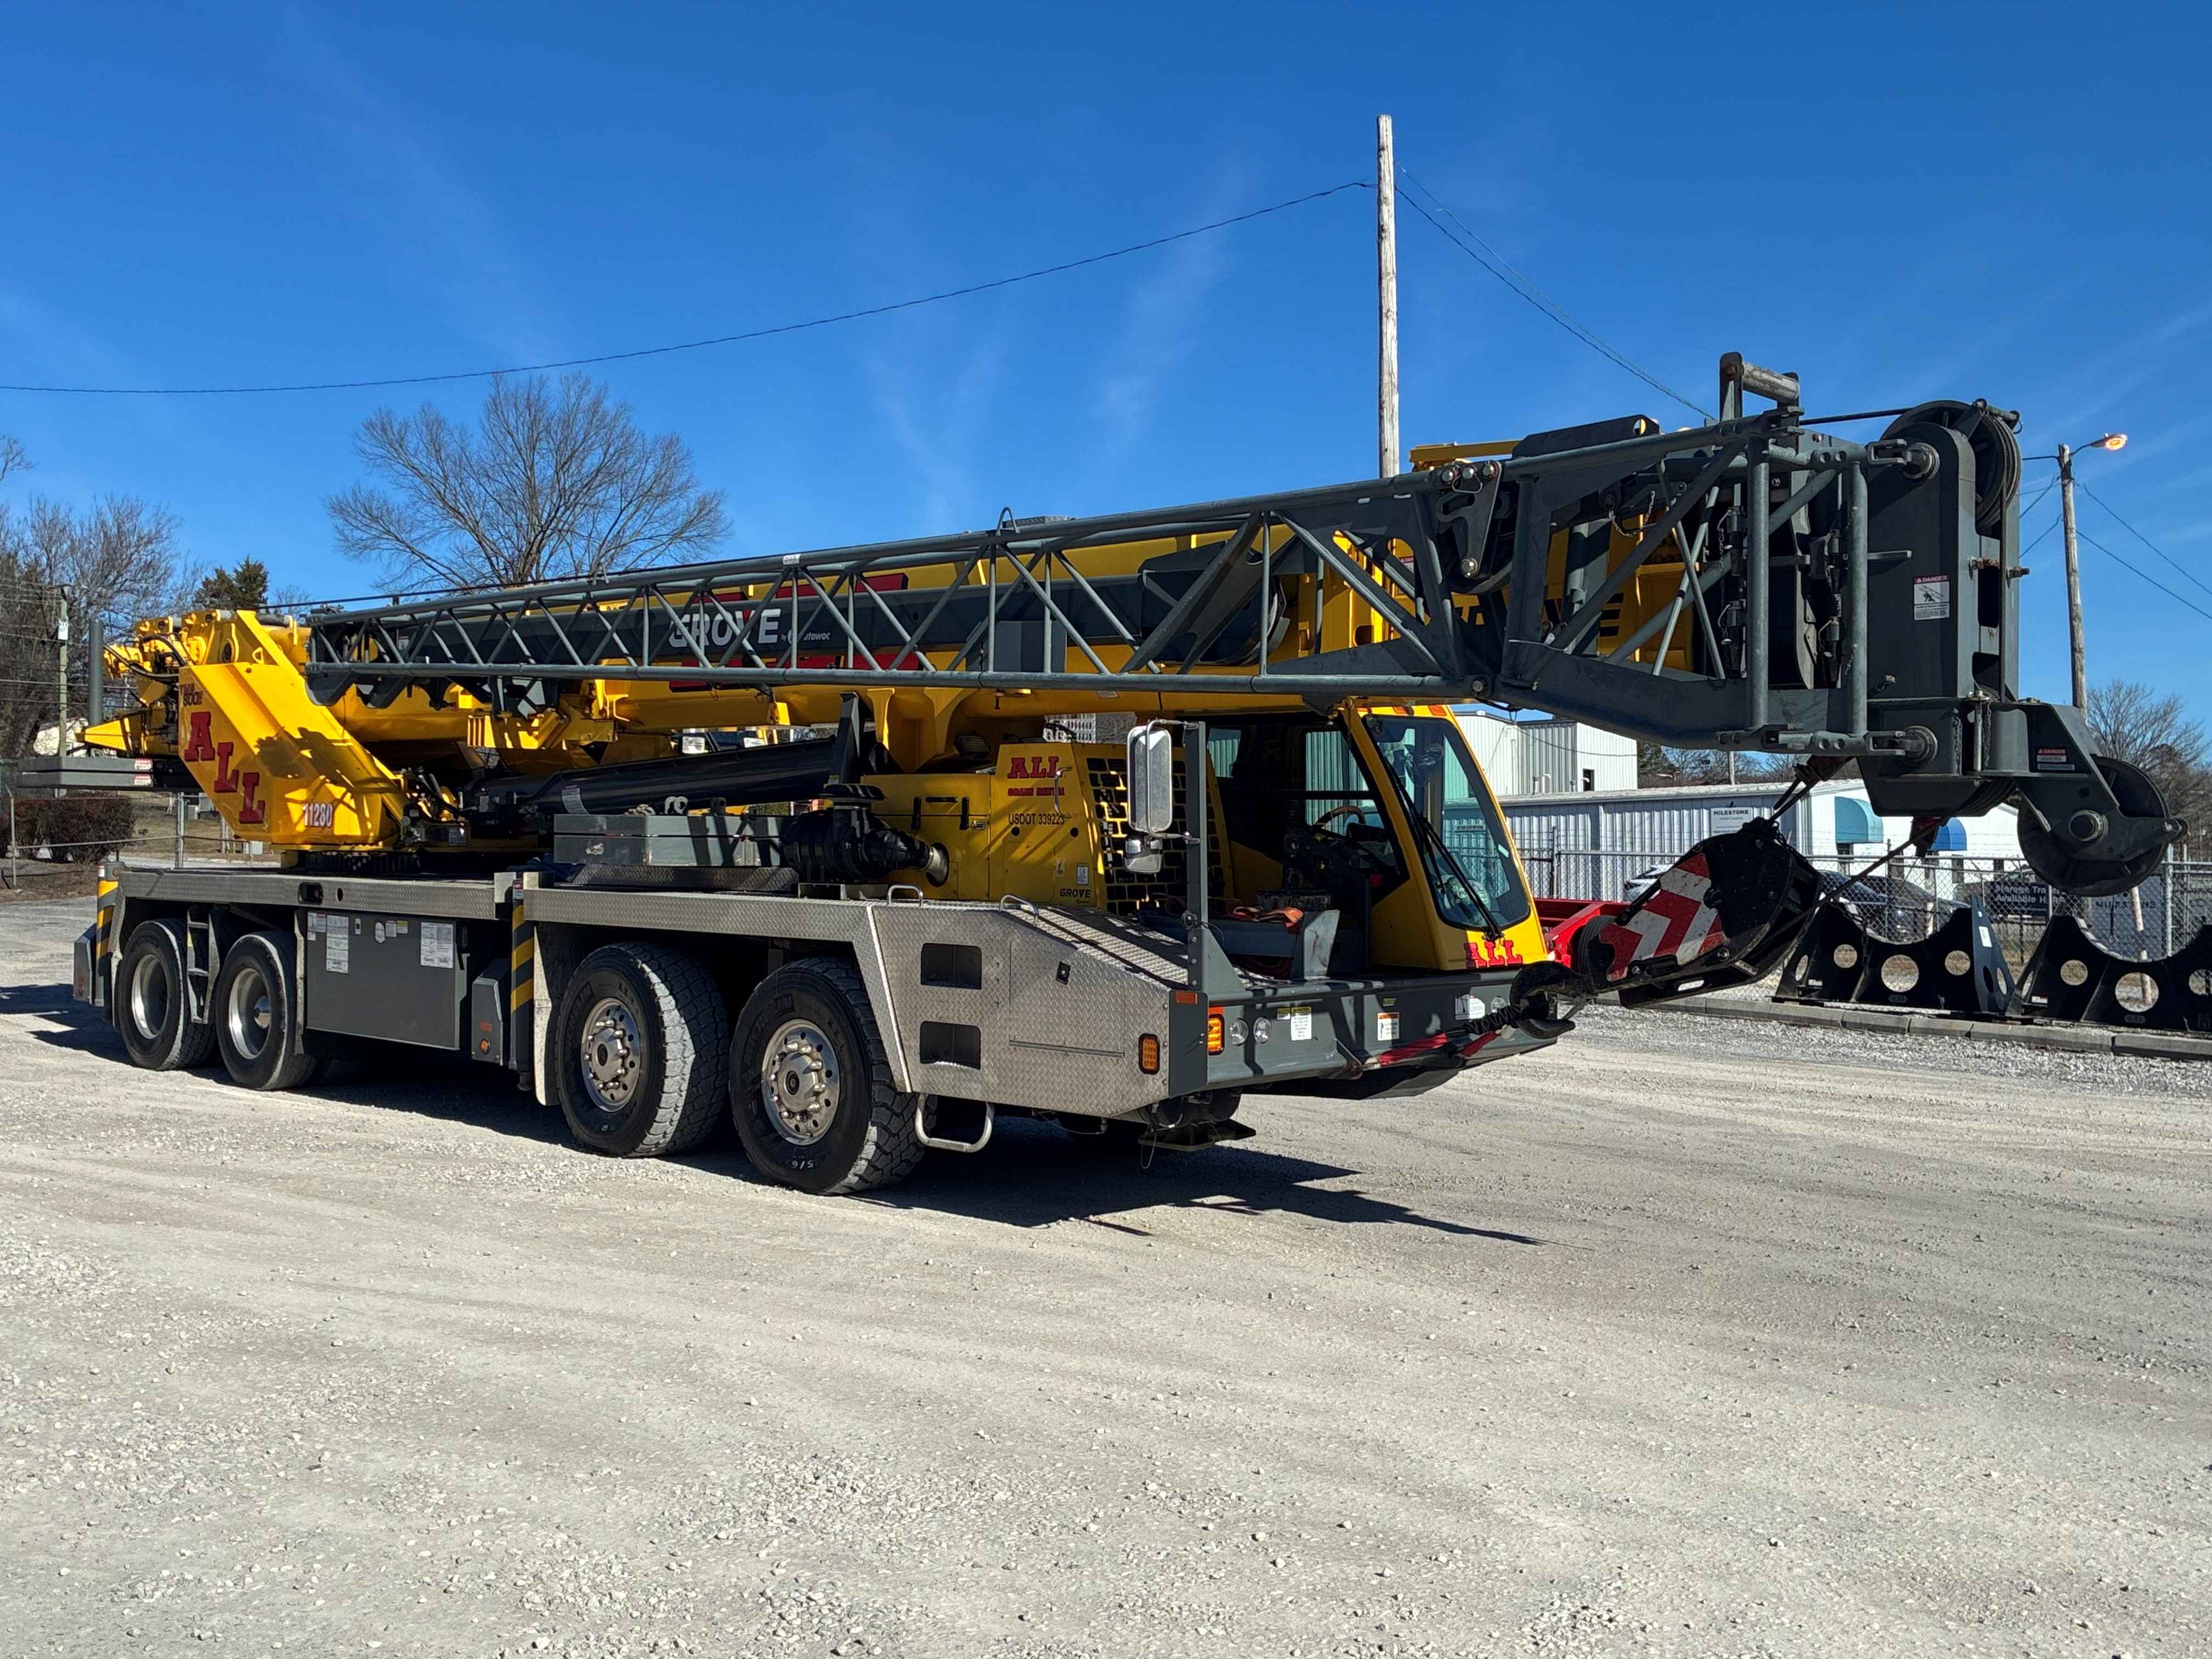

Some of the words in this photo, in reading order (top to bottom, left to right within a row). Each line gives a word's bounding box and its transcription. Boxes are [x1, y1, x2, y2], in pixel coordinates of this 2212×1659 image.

[184, 711, 266, 824] ALL
[1007, 757, 1063, 778] ALL
[1036, 787, 1065, 796] RENTL
[302, 803, 333, 827] 11280
[1008, 813, 1036, 825] USDOT
[1060, 888, 1091, 898] GROVE
[1995, 884, 2030, 894] Storage
[2032, 885, 2067, 895] Traers
[1996, 894, 2036, 904] Available
[2095, 901, 2157, 909] MILESNE
[1463, 940, 1523, 969] ALL
